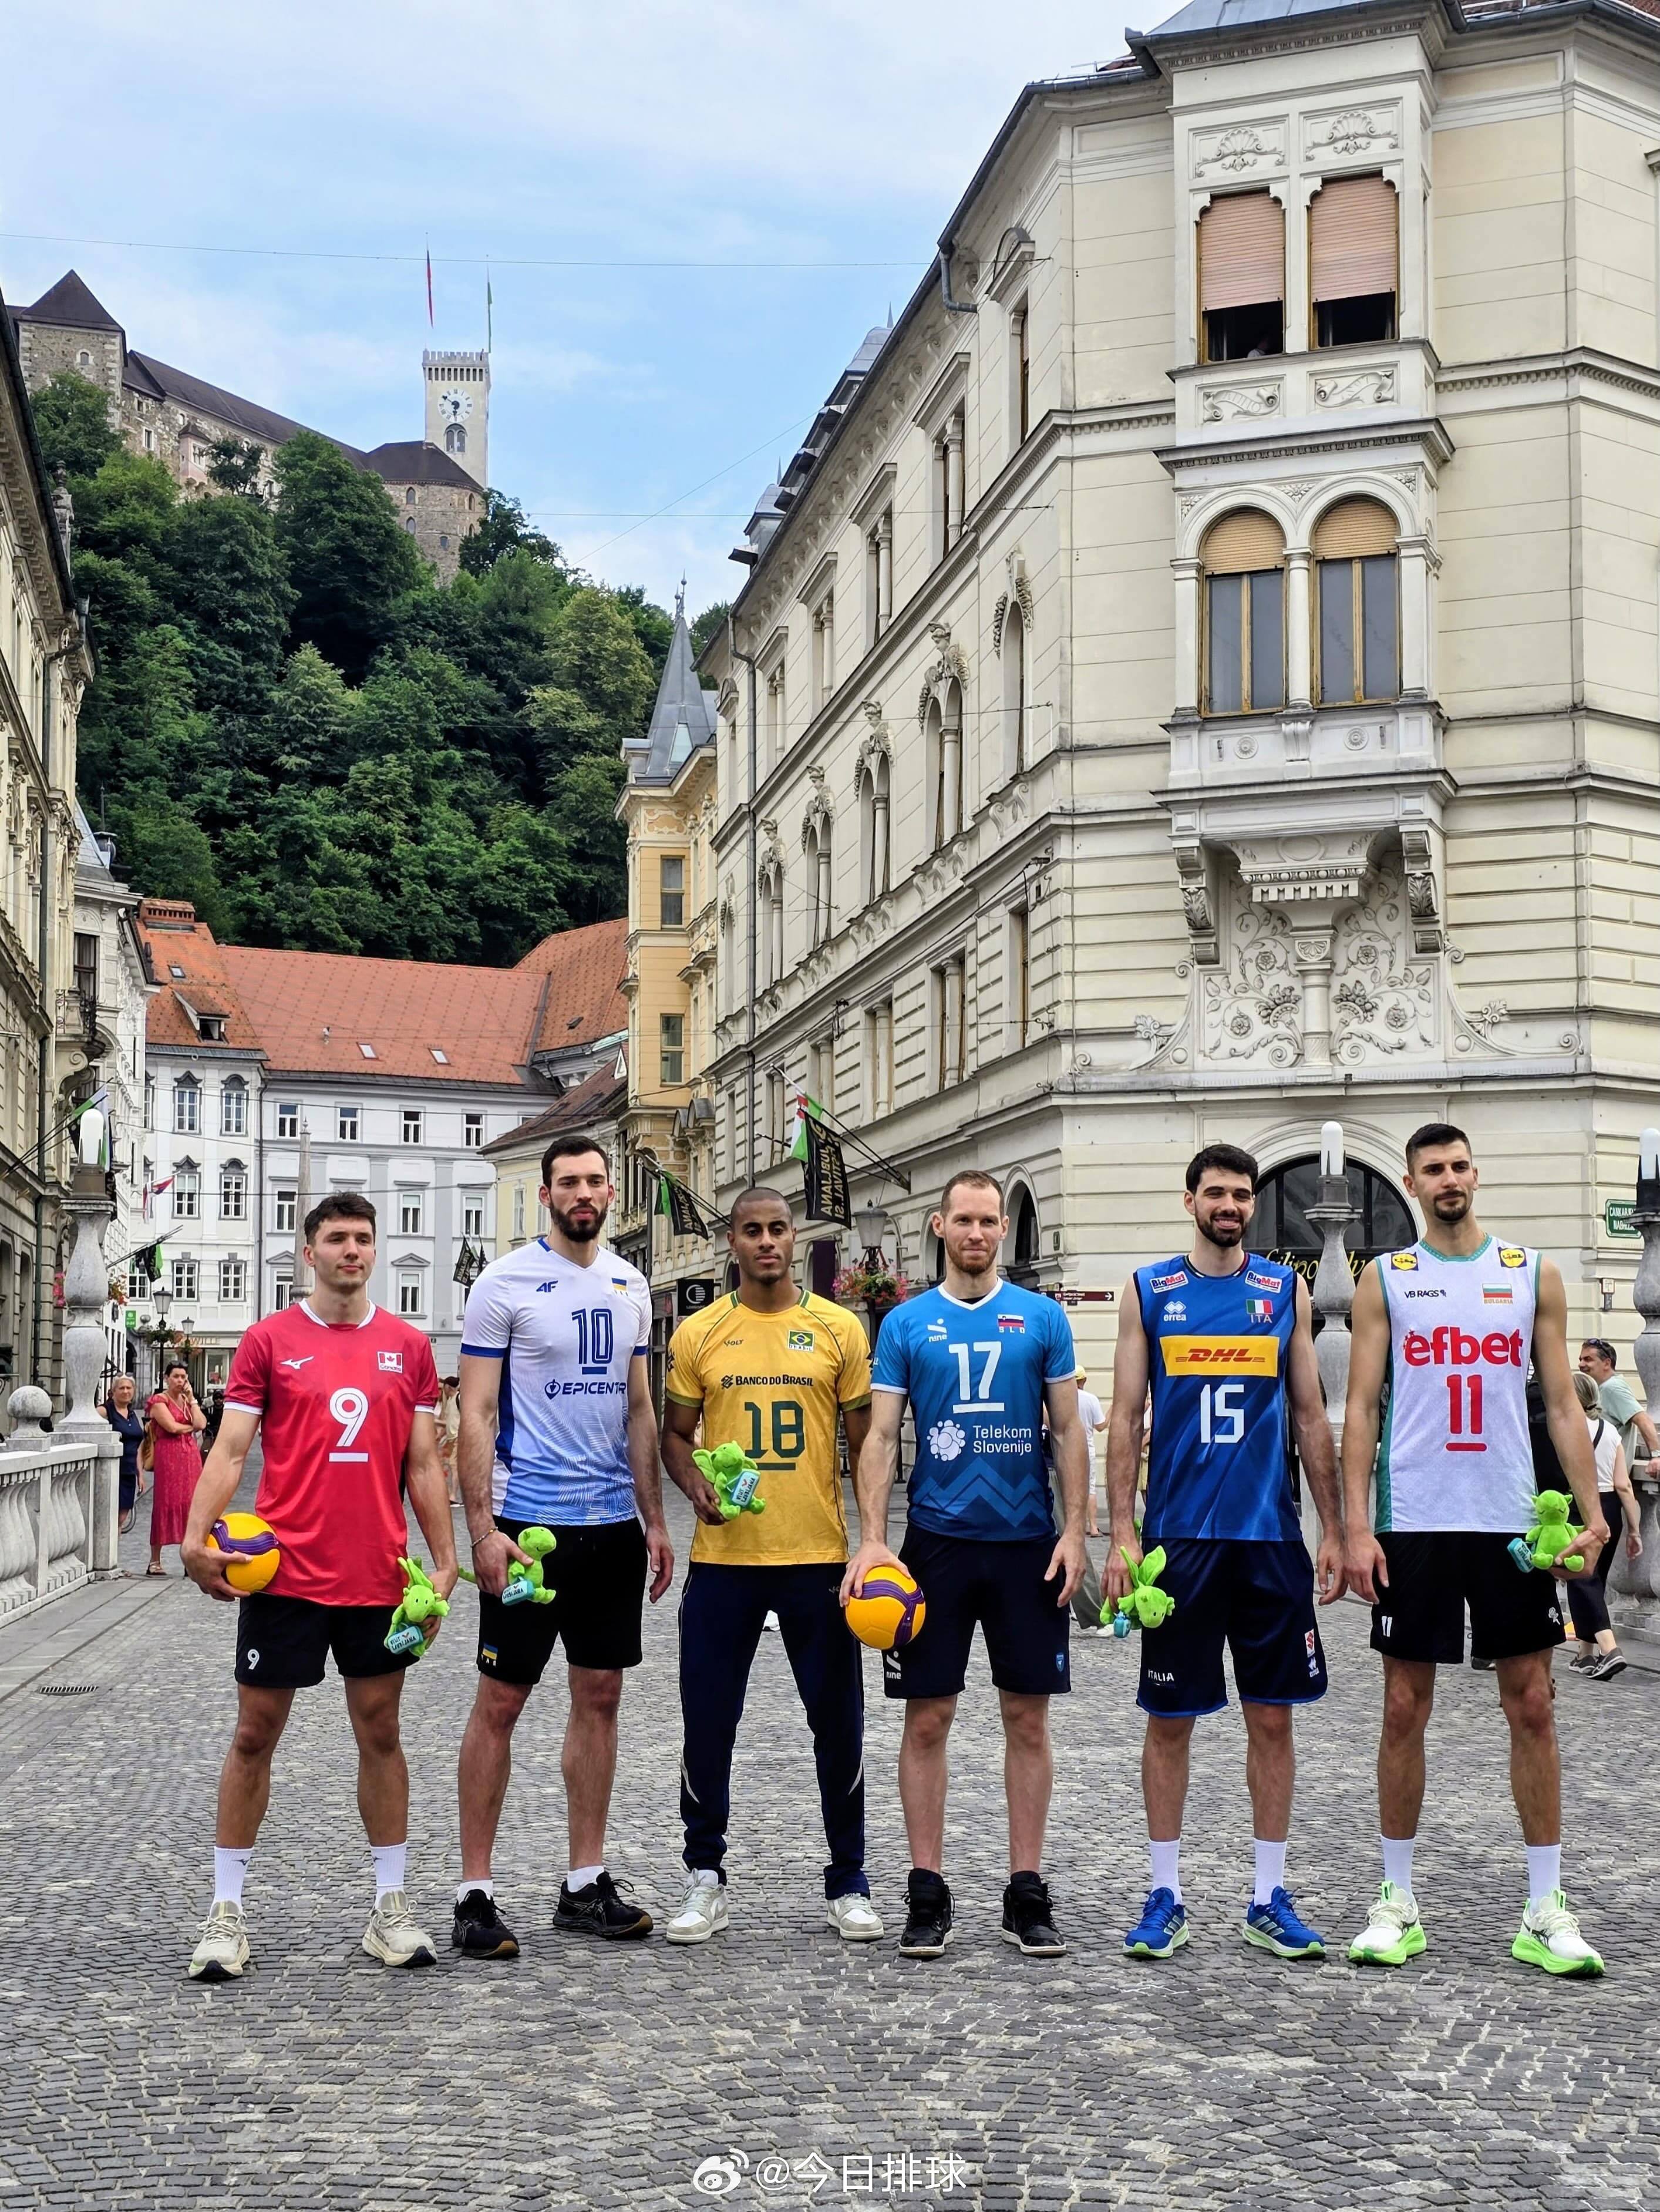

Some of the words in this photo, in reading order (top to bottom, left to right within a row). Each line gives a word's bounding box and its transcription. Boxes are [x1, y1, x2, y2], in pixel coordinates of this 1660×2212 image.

[1247, 1272, 1281, 1287] BigMat
[1404, 1290, 1416, 1299] VB
[1417, 1289, 1439, 1297] RAGS
[1250, 1314, 1273, 1323] ITA
[571, 1308, 614, 1364] 10
[928, 1334, 947, 1343] nine
[1403, 1326, 1523, 1367] efbet
[1187, 1348, 1254, 1363] DHL
[948, 1341, 1002, 1400] 17
[735, 1375, 769, 1386] BANCO
[769, 1377, 781, 1386] DO
[782, 1374, 814, 1387] BRASIL
[1446, 1374, 1483, 1434] 11
[329, 1387, 369, 1447] 9
[1200, 1384, 1244, 1443] 15
[744, 1400, 806, 1459] 18
[972, 1424, 1032, 1439] Telekom
[973, 1440, 1032, 1456] Slovenije
[1381, 1615, 1393, 1638] 11
[247, 1649, 260, 1670] 9
[886, 1671, 901, 1679] nine
[1147, 1669, 1174, 1682] ITALIA
